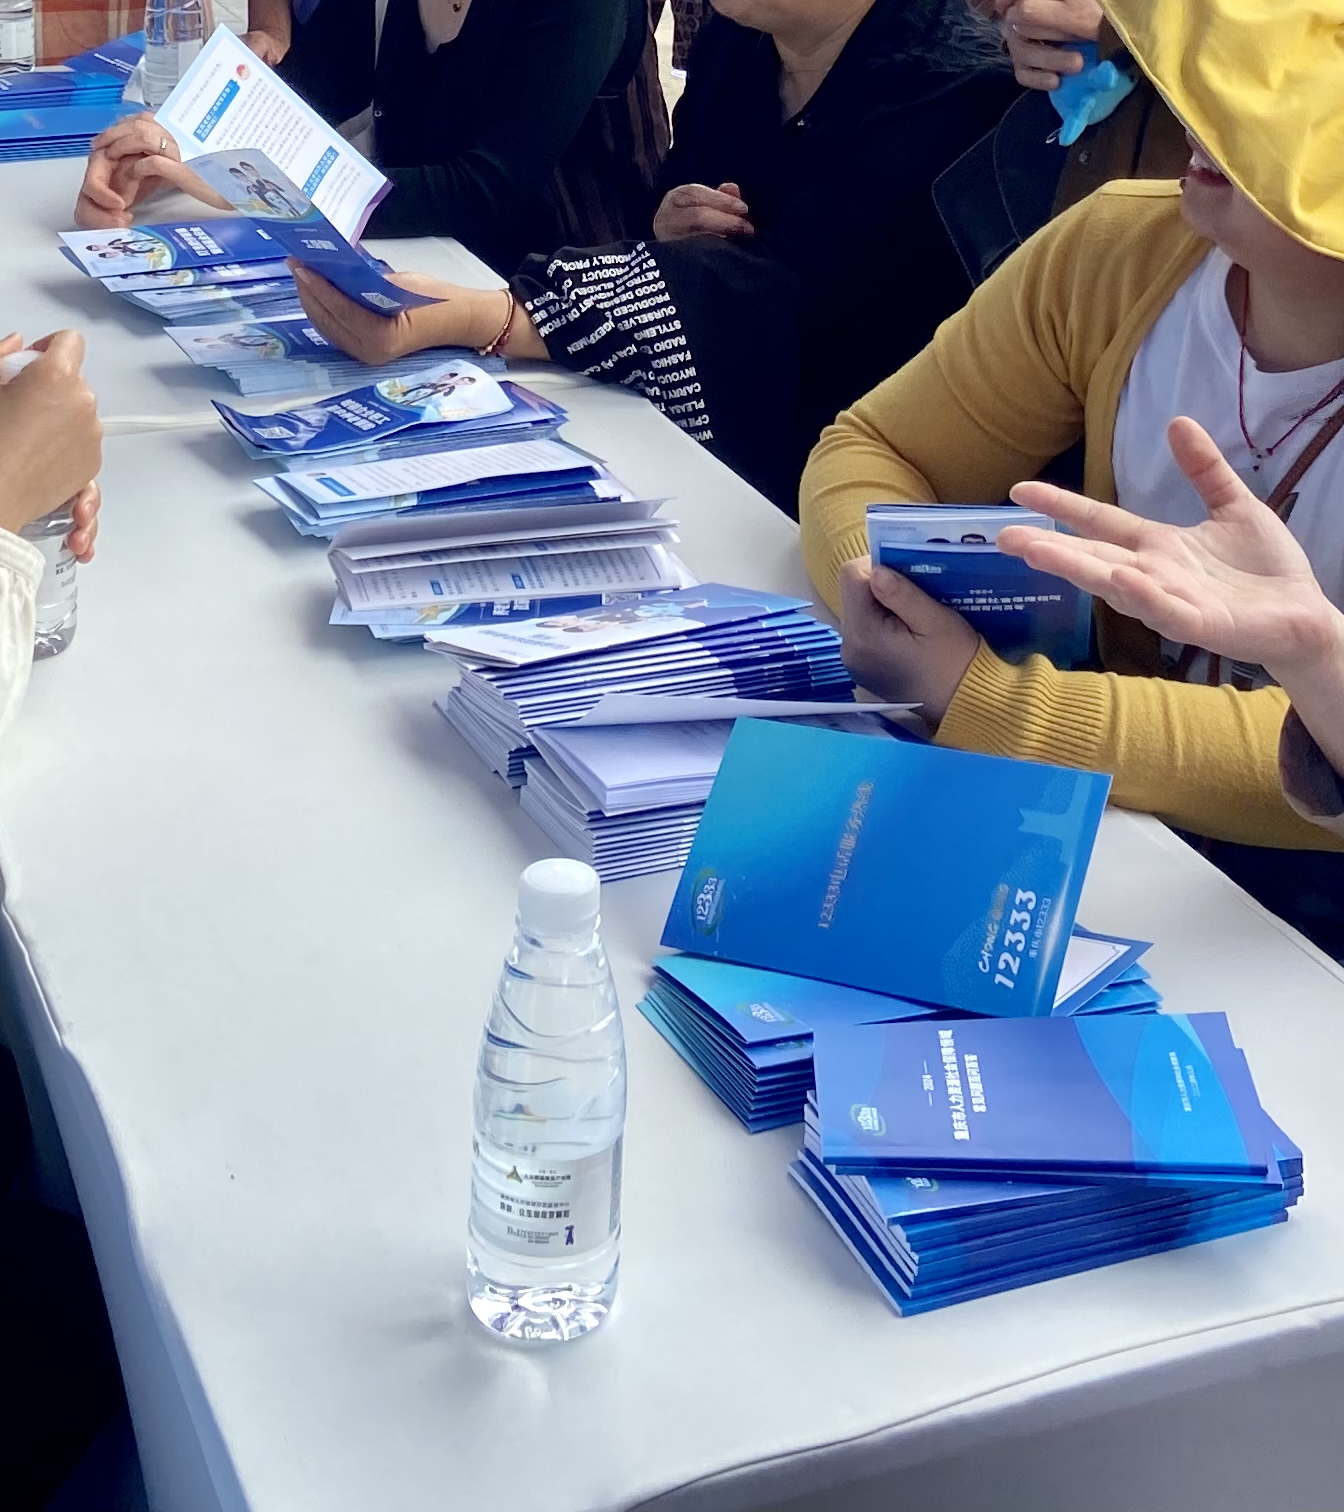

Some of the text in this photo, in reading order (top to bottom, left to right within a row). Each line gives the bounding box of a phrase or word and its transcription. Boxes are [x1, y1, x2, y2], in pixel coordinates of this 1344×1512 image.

[613, 292, 670, 317] PRODUCED
[616, 305, 676, 331] OURSELVES
[653, 334, 686, 352] RADIO
[993, 887, 1038, 990] 12333
